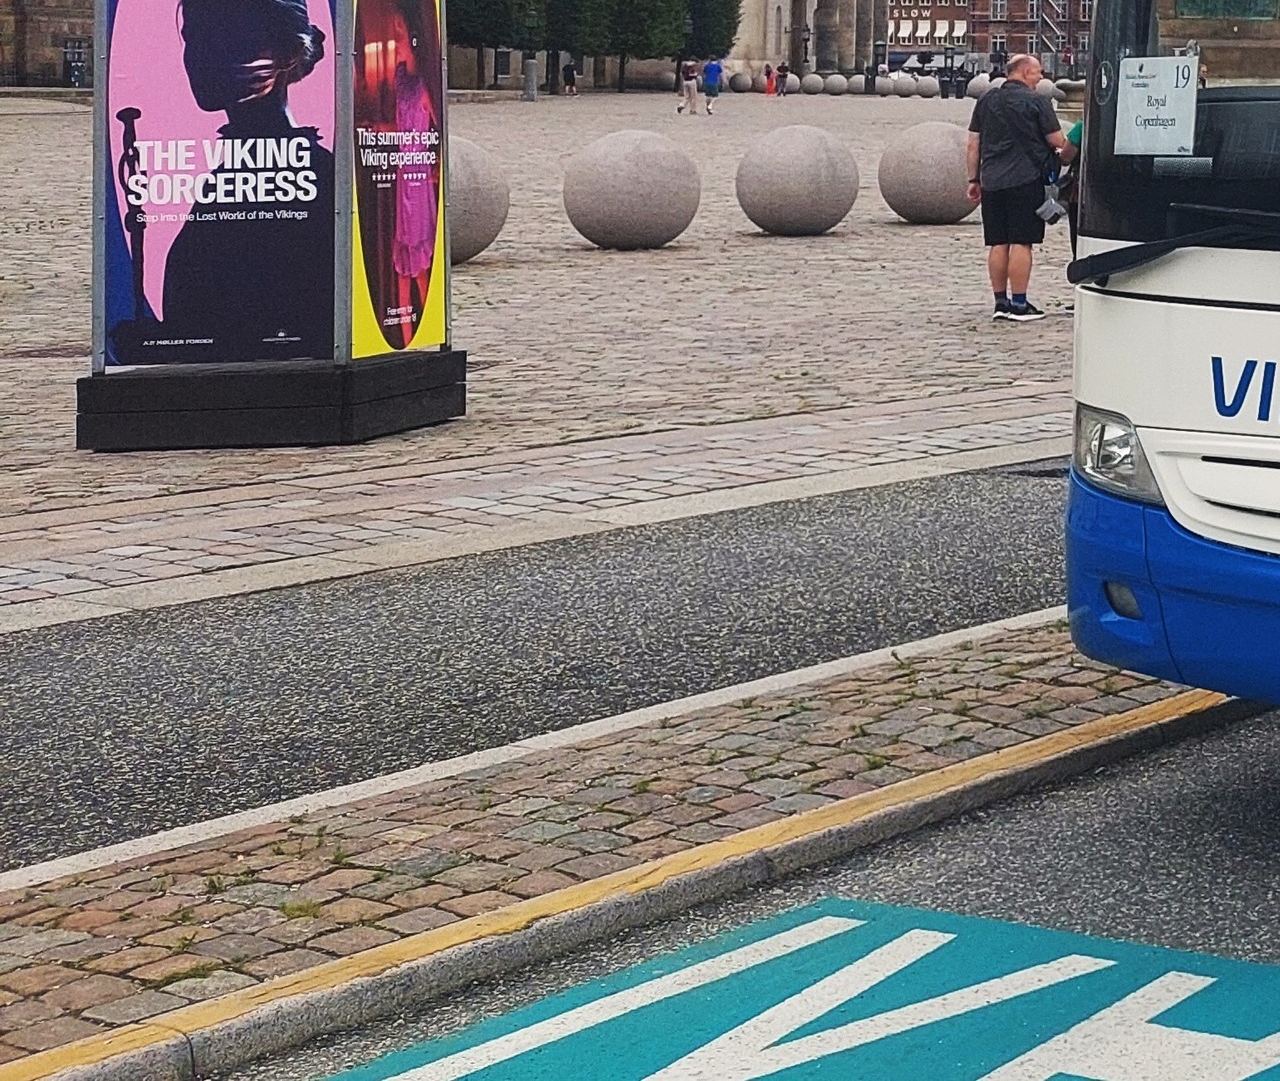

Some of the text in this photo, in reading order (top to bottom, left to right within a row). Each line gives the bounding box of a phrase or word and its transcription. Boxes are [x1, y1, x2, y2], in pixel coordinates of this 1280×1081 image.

[1174, 64, 1191, 88] 19
[1146, 95, 1167, 109] Royal
[1135, 115, 1176, 129] Copenhagen
[356, 127, 439, 148] This summer's epic
[133, 137, 311, 171] THE VIKING
[360, 148, 436, 170] Viking experience
[127, 170, 318, 206] SORCERESS
[196, 211, 217, 221] Lost
[219, 211, 246, 221] World
[247, 210, 257, 219] of
[258, 210, 274, 220] the
[275, 210, 308, 220] Vikings
